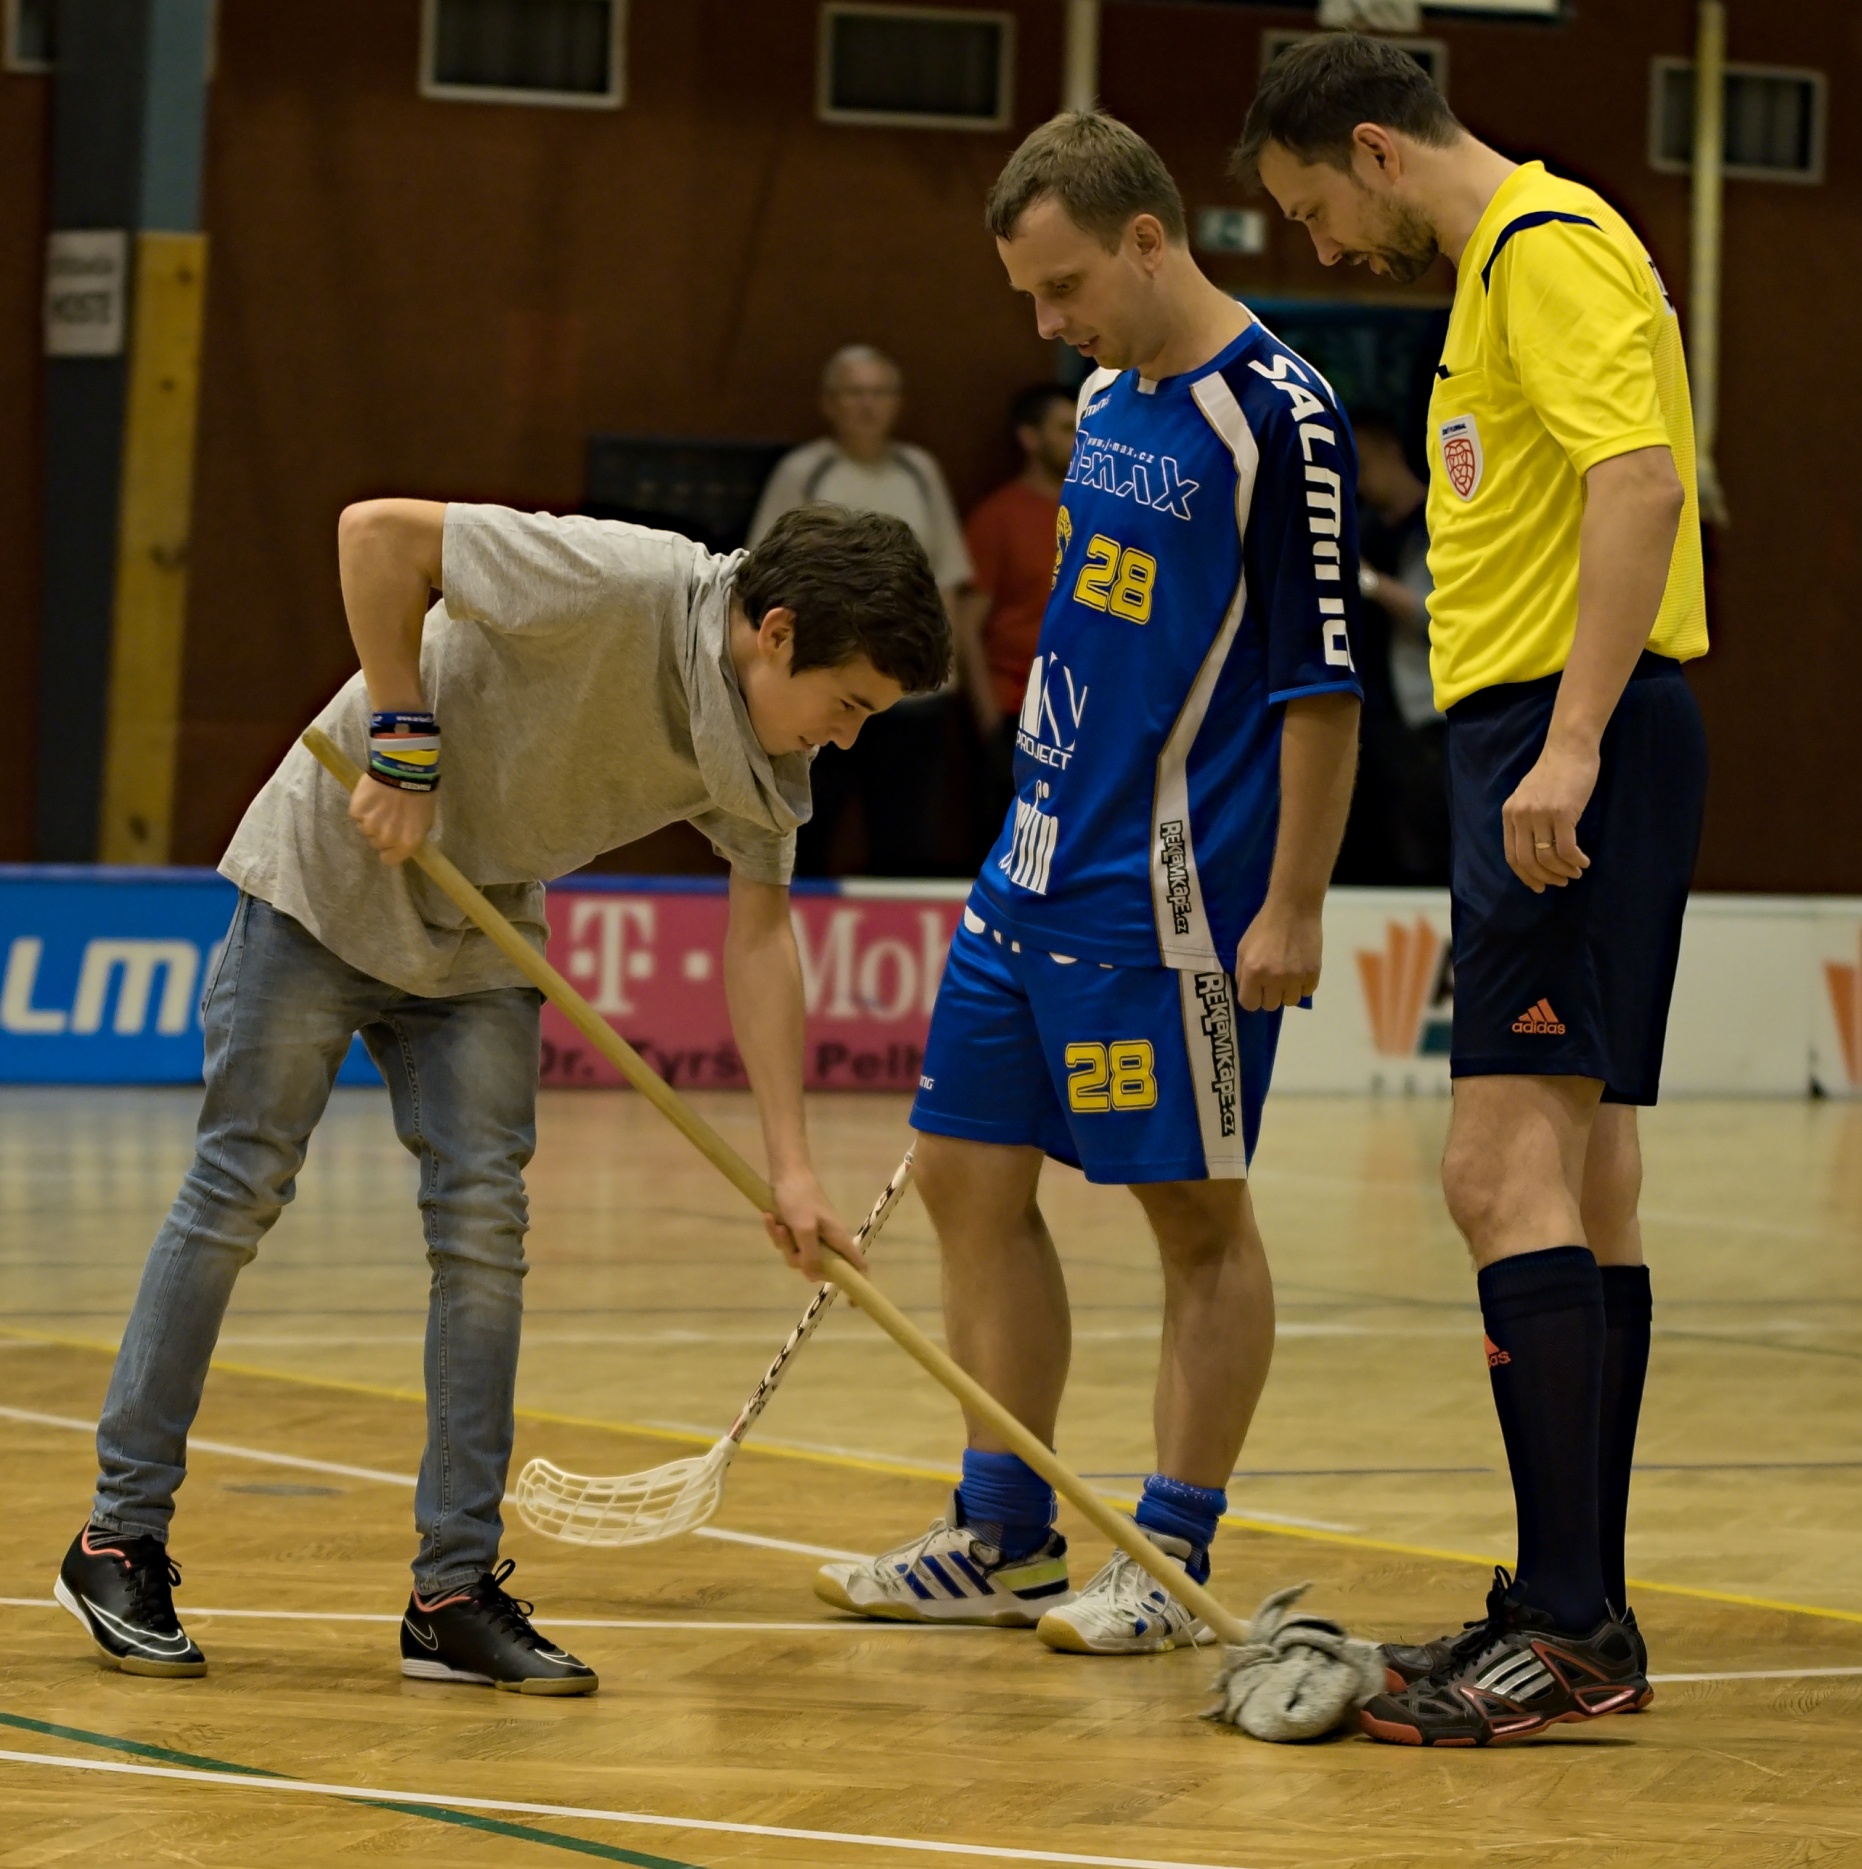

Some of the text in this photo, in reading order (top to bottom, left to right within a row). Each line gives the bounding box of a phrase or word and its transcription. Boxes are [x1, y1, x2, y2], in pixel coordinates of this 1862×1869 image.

[1073, 533, 1157, 625] 28
[1016, 730, 1072, 771] PROJECT
[1, 936, 222, 1037] LM
[1511, 1020, 1566, 1035] adidas
[1065, 1039, 1158, 1113] 28
